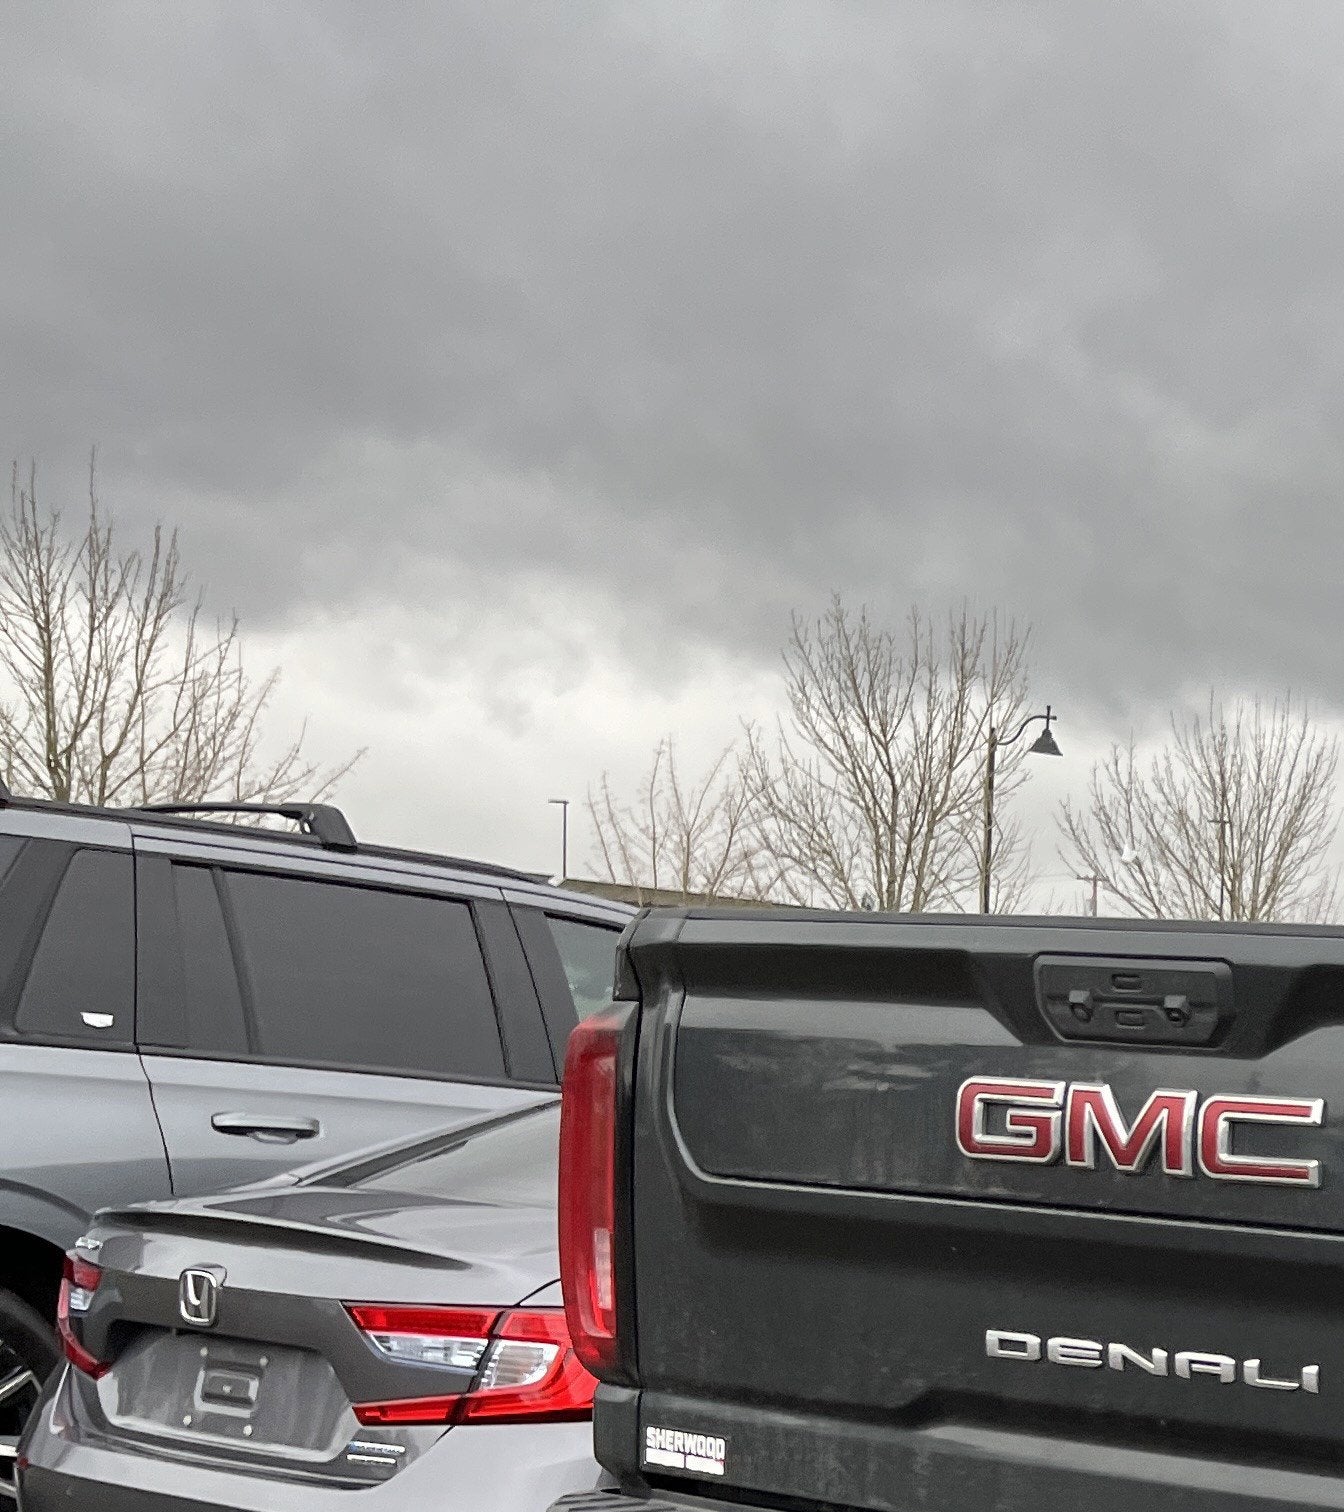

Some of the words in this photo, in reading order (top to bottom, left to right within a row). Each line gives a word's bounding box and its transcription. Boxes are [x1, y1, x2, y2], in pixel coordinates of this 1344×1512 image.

[955, 1075, 1324, 1189] GMC
[985, 1329, 1320, 1394] DENALI
[646, 1426, 726, 1460] SHERWOOD
